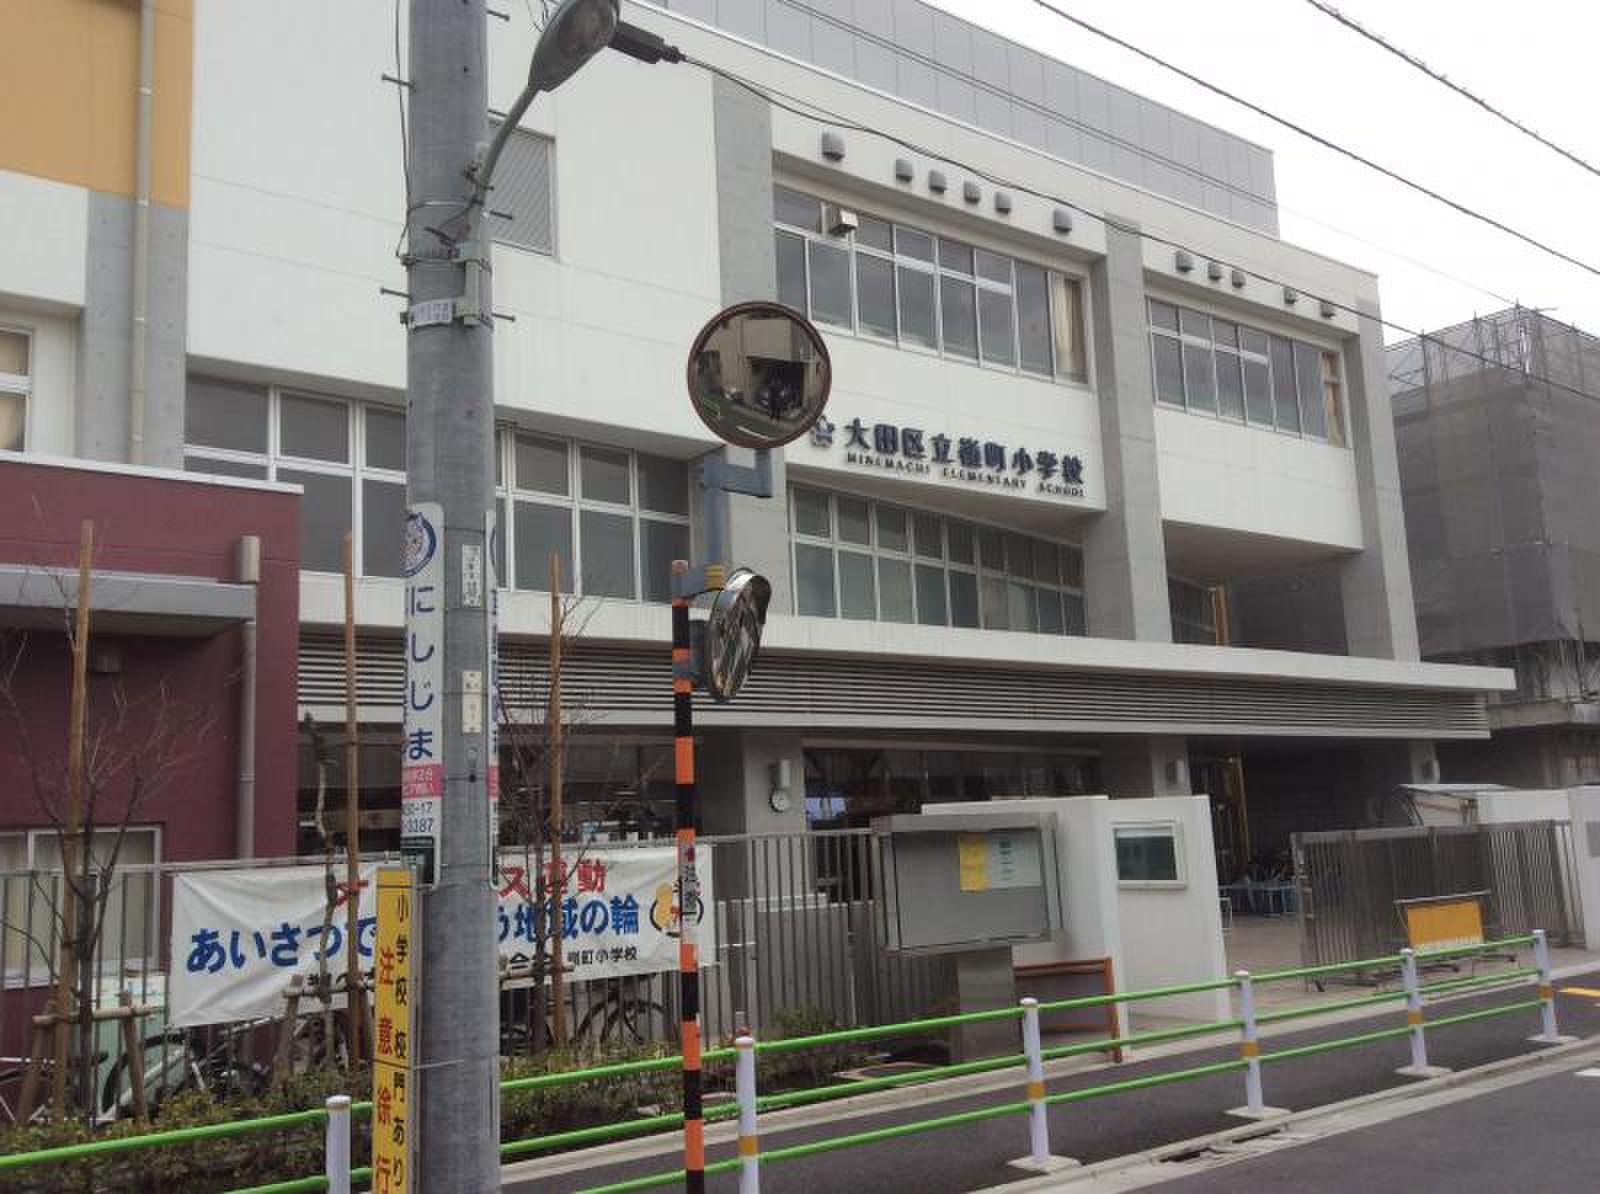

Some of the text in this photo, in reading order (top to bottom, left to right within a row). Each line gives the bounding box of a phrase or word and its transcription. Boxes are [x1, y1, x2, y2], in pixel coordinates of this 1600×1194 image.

[847, 451, 1085, 498] MINEMACHI ELEMENTARY SCHOOL
[406, 585, 434, 760] にしじま
